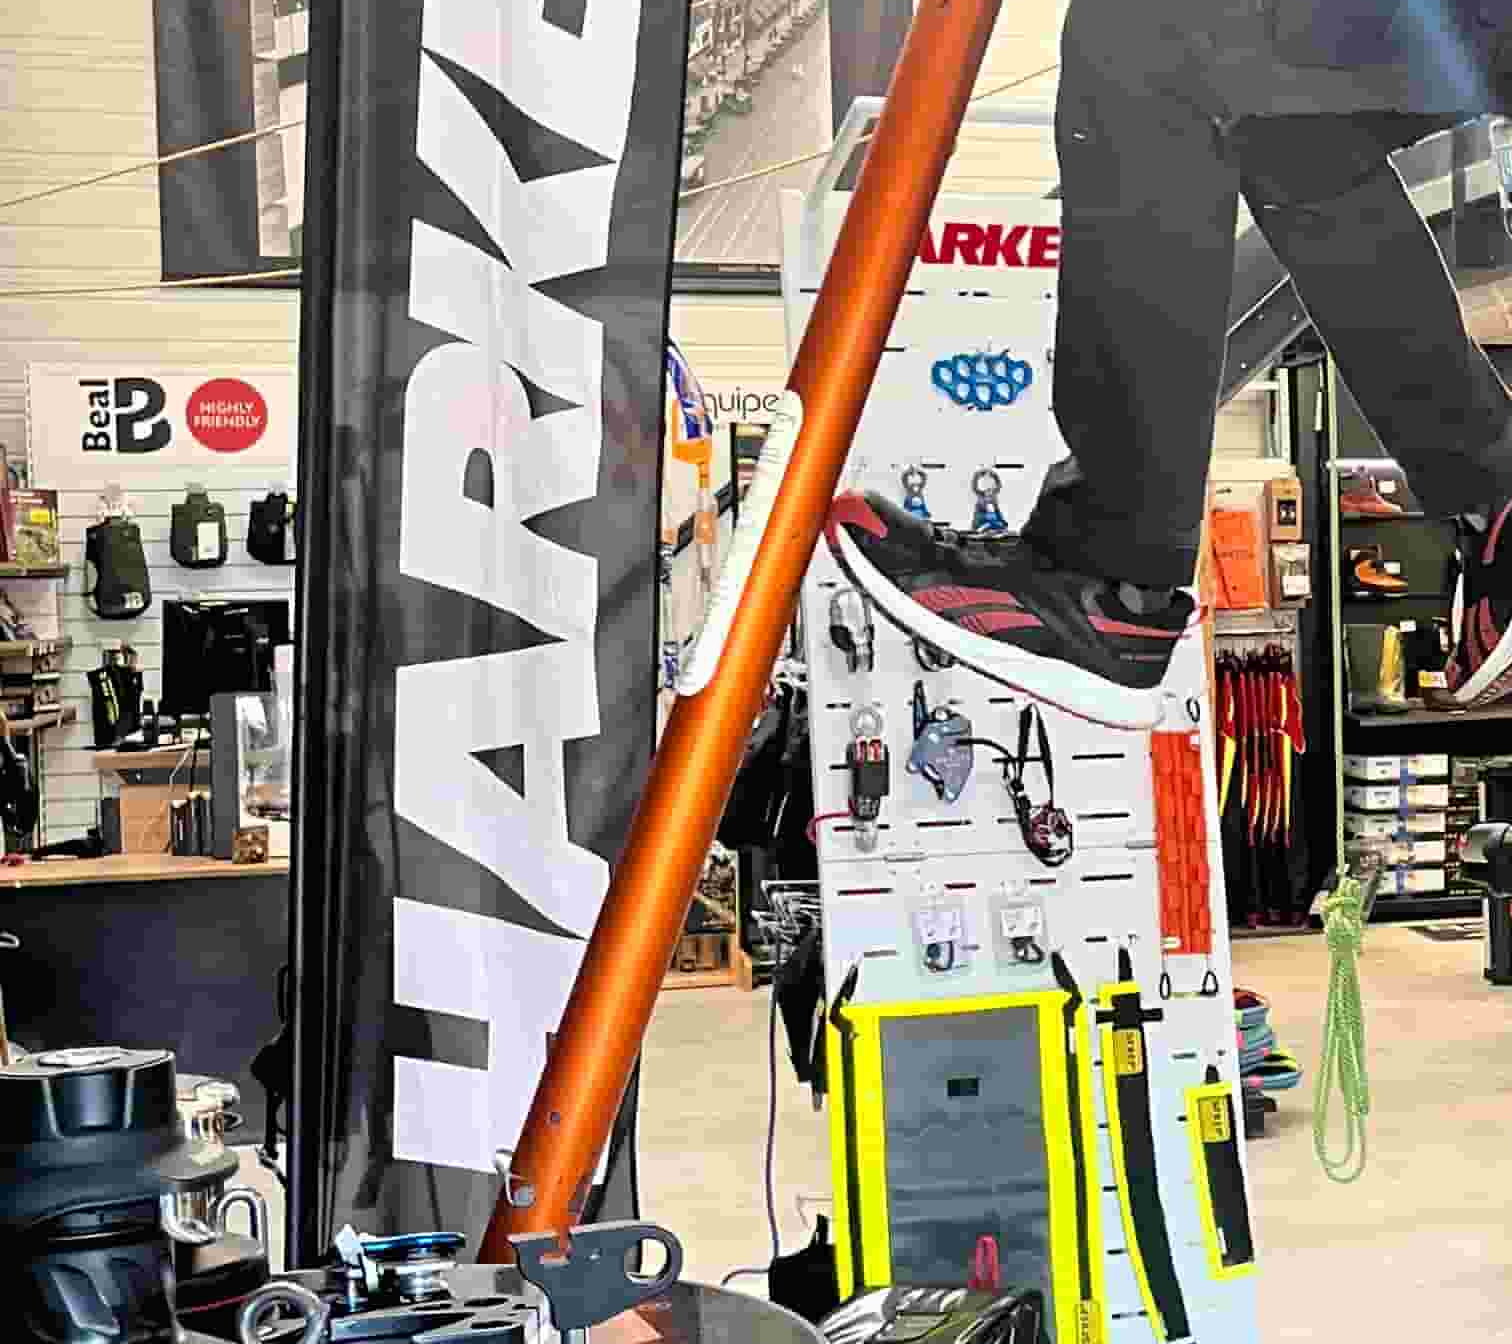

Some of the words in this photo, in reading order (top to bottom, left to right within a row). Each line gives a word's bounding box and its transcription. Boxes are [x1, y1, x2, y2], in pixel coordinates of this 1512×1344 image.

[80, 379, 112, 451] Beal
[199, 400, 255, 415] HIGHLY
[702, 385, 779, 420] quipe
